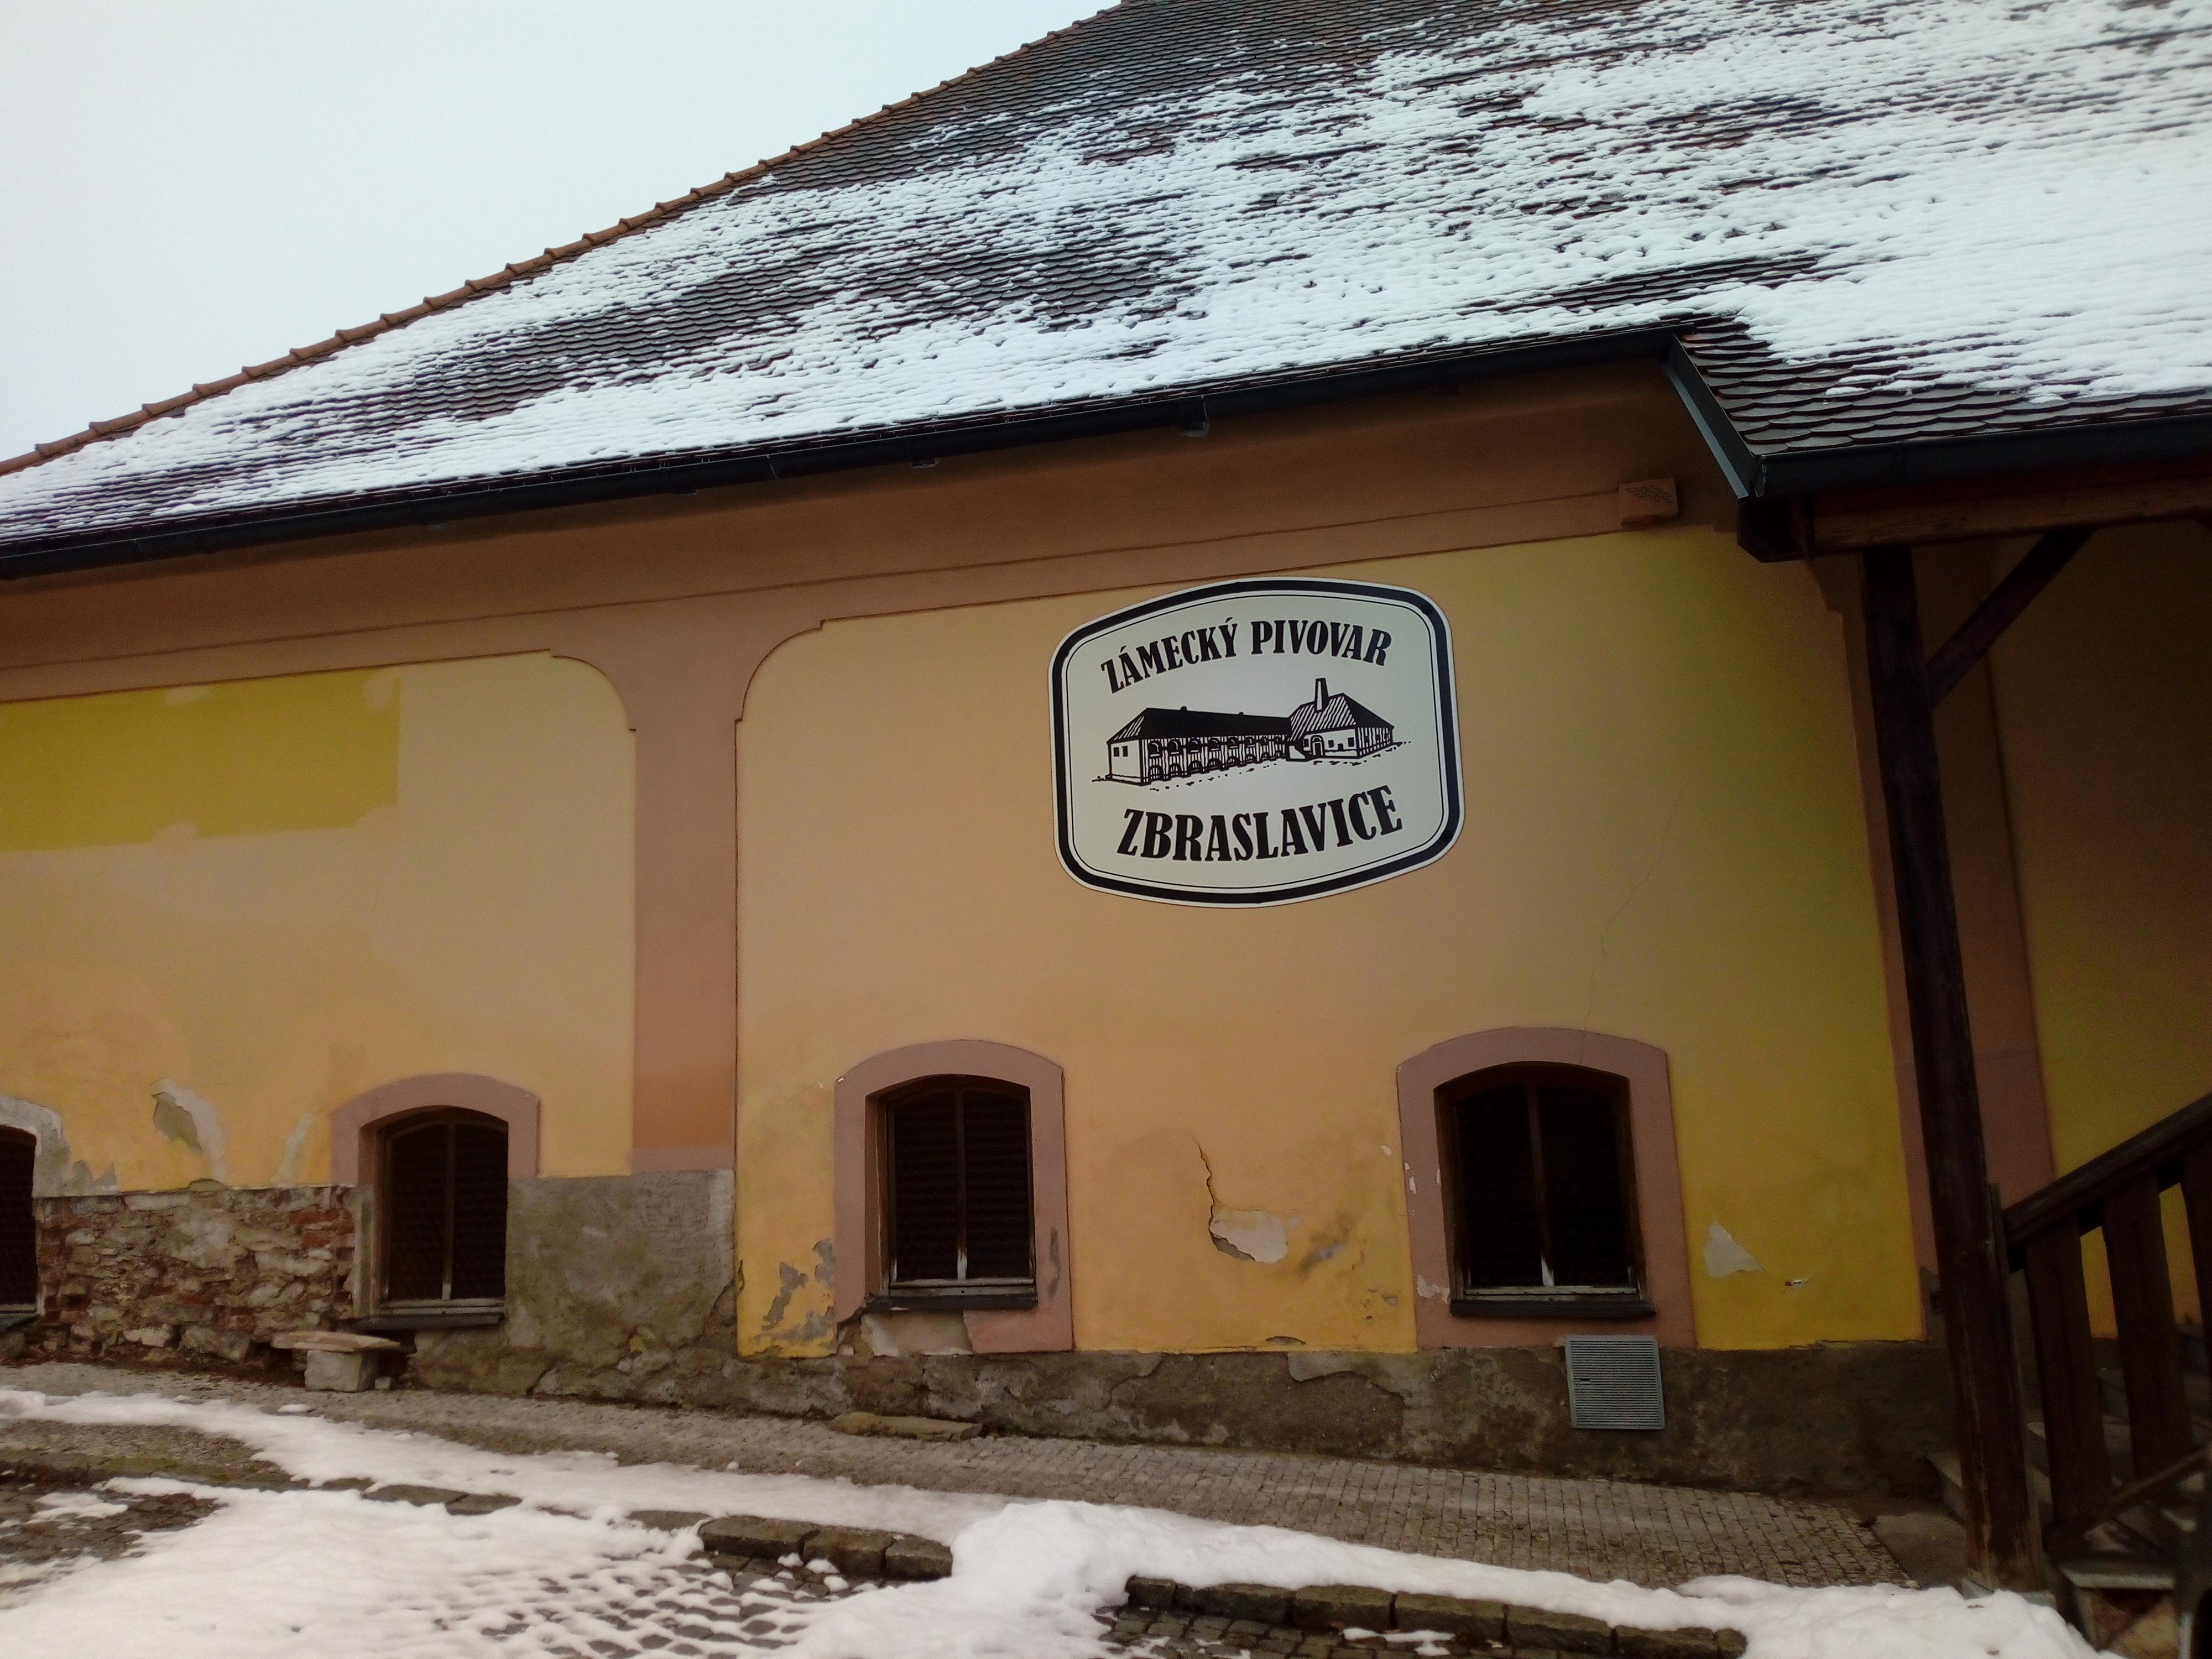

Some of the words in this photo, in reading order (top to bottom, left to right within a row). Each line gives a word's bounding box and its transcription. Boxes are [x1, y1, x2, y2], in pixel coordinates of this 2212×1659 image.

[1101, 617, 1238, 693] ZÁMECKÝ
[1250, 620, 1392, 666] PIVOVAR
[1117, 785, 1403, 862] ZBRASLAVICE
